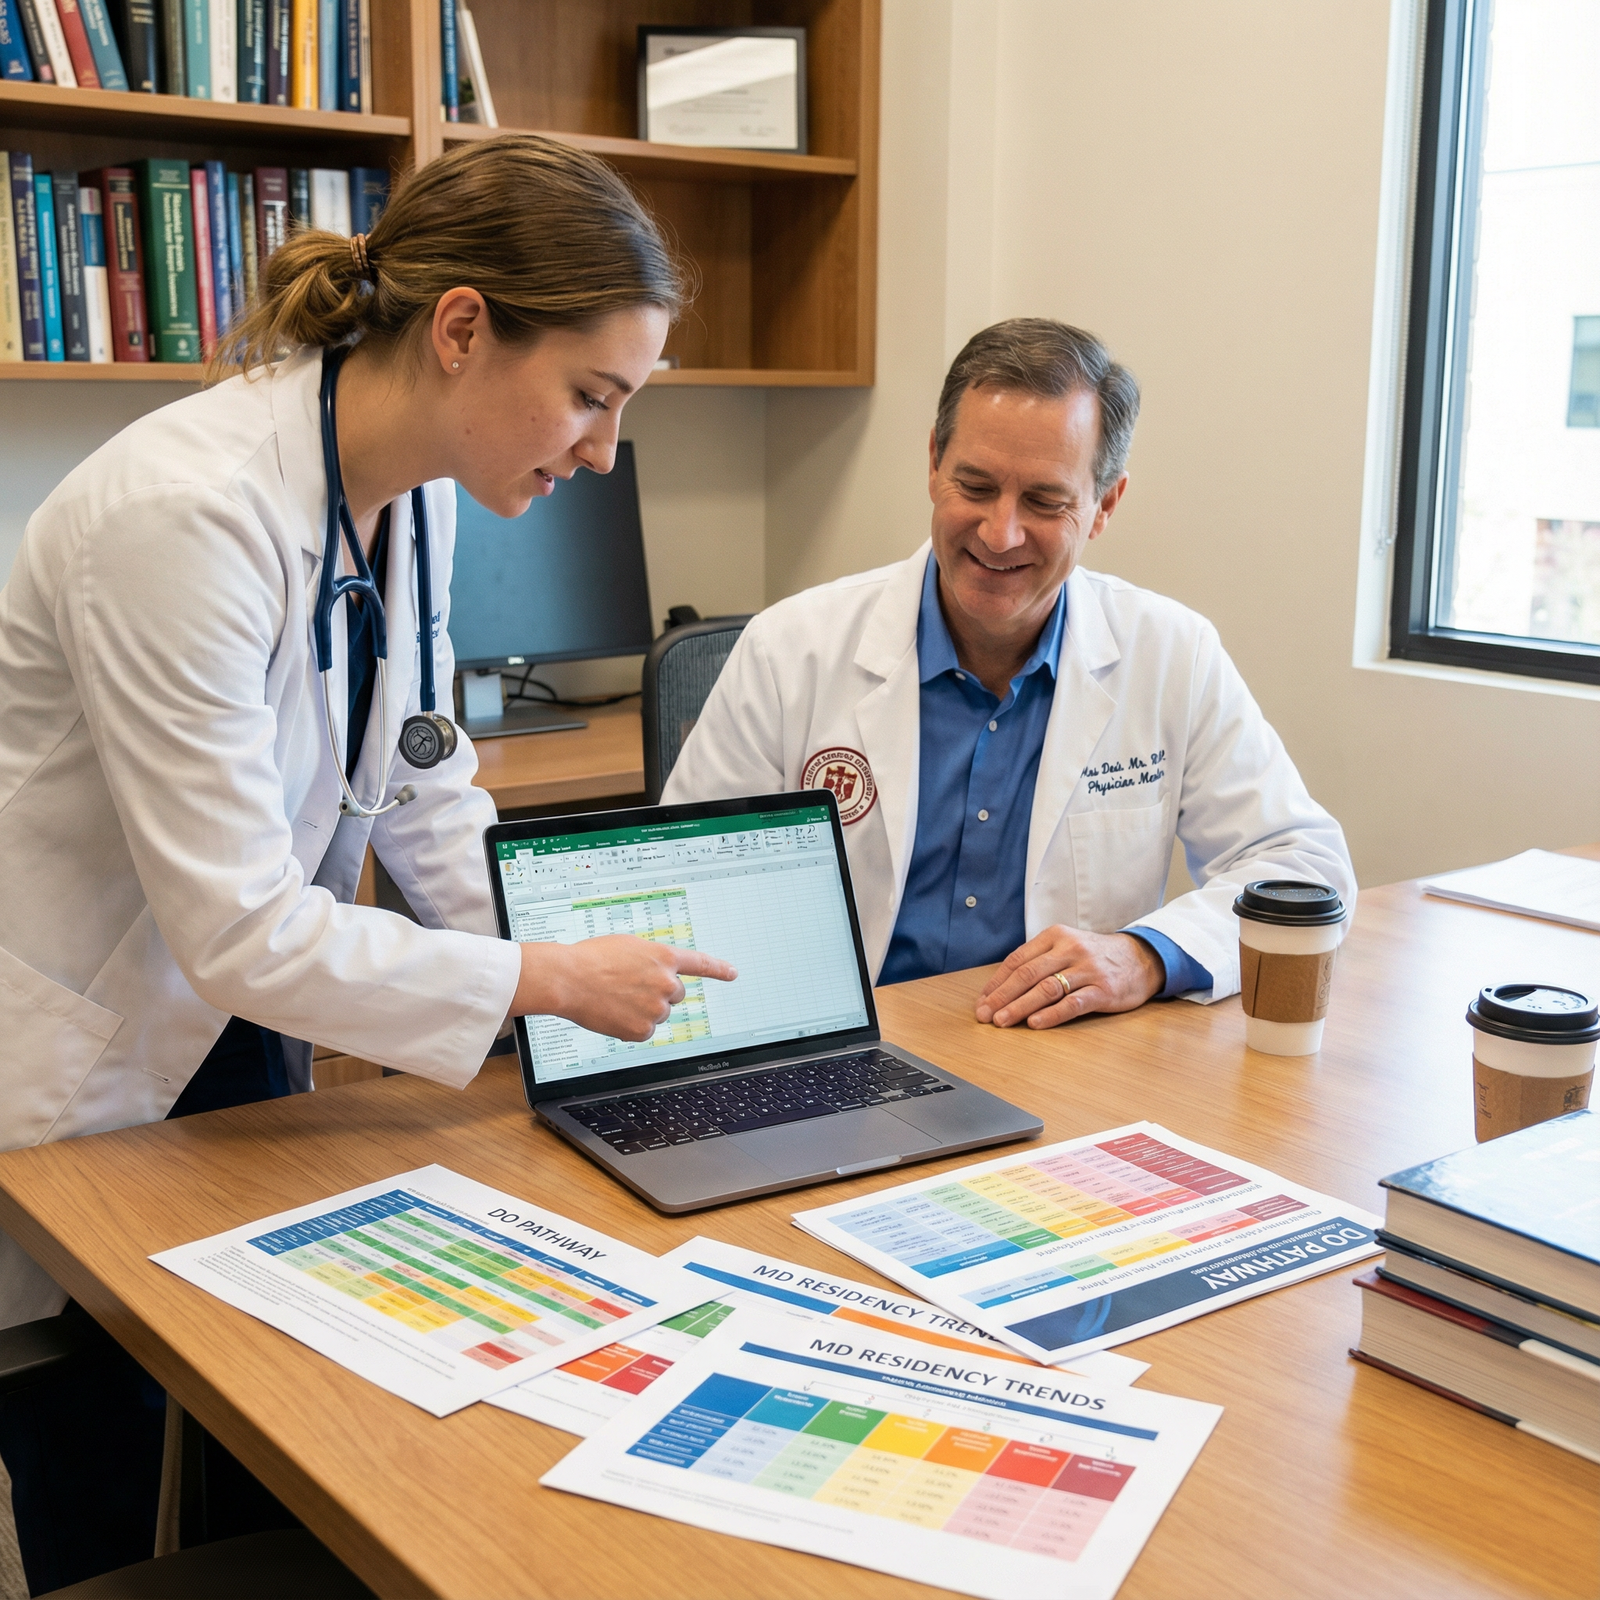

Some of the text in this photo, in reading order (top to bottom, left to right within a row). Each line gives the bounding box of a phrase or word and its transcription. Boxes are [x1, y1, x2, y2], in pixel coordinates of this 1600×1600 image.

[1088, 776, 1135, 796] Physician
[487, 1208, 607, 1261] DO PATHWAY
[1321, 1227, 1368, 1247] DO
[752, 1264, 794, 1283] MD
[796, 1277, 924, 1319] RESIDENCY
[1200, 1240, 1328, 1291] PATHWAY
[809, 1338, 854, 1356] MD
[858, 1349, 998, 1387] RESIDENCY
[1004, 1378, 1107, 1411] TRENDS
